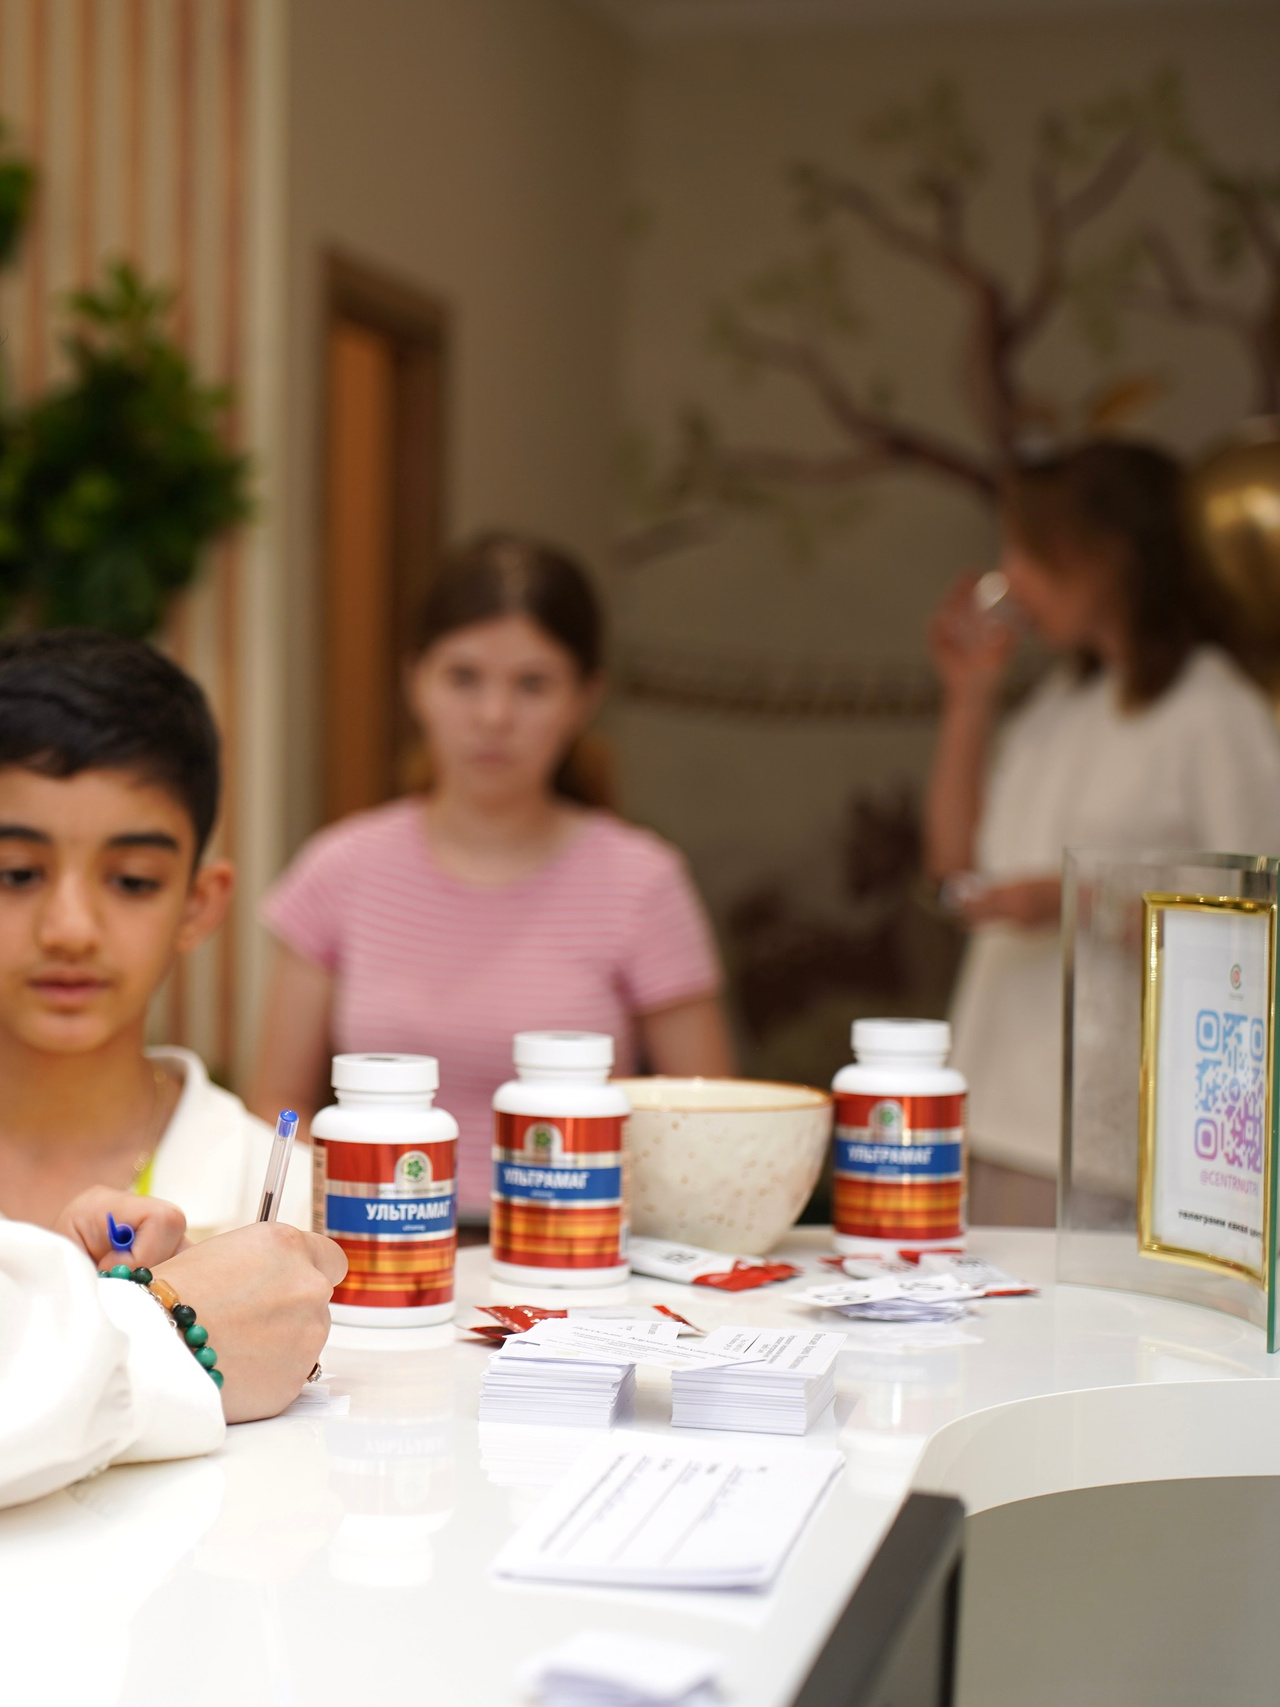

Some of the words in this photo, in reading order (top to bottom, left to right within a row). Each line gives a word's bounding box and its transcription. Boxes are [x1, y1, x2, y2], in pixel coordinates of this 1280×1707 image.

[847, 1144, 934, 1165] УЛЬТРАМАГ
[503, 1167, 591, 1190] УЛЬТРАМАГ
[365, 1200, 451, 1221] УЛЬТРАМАГ
